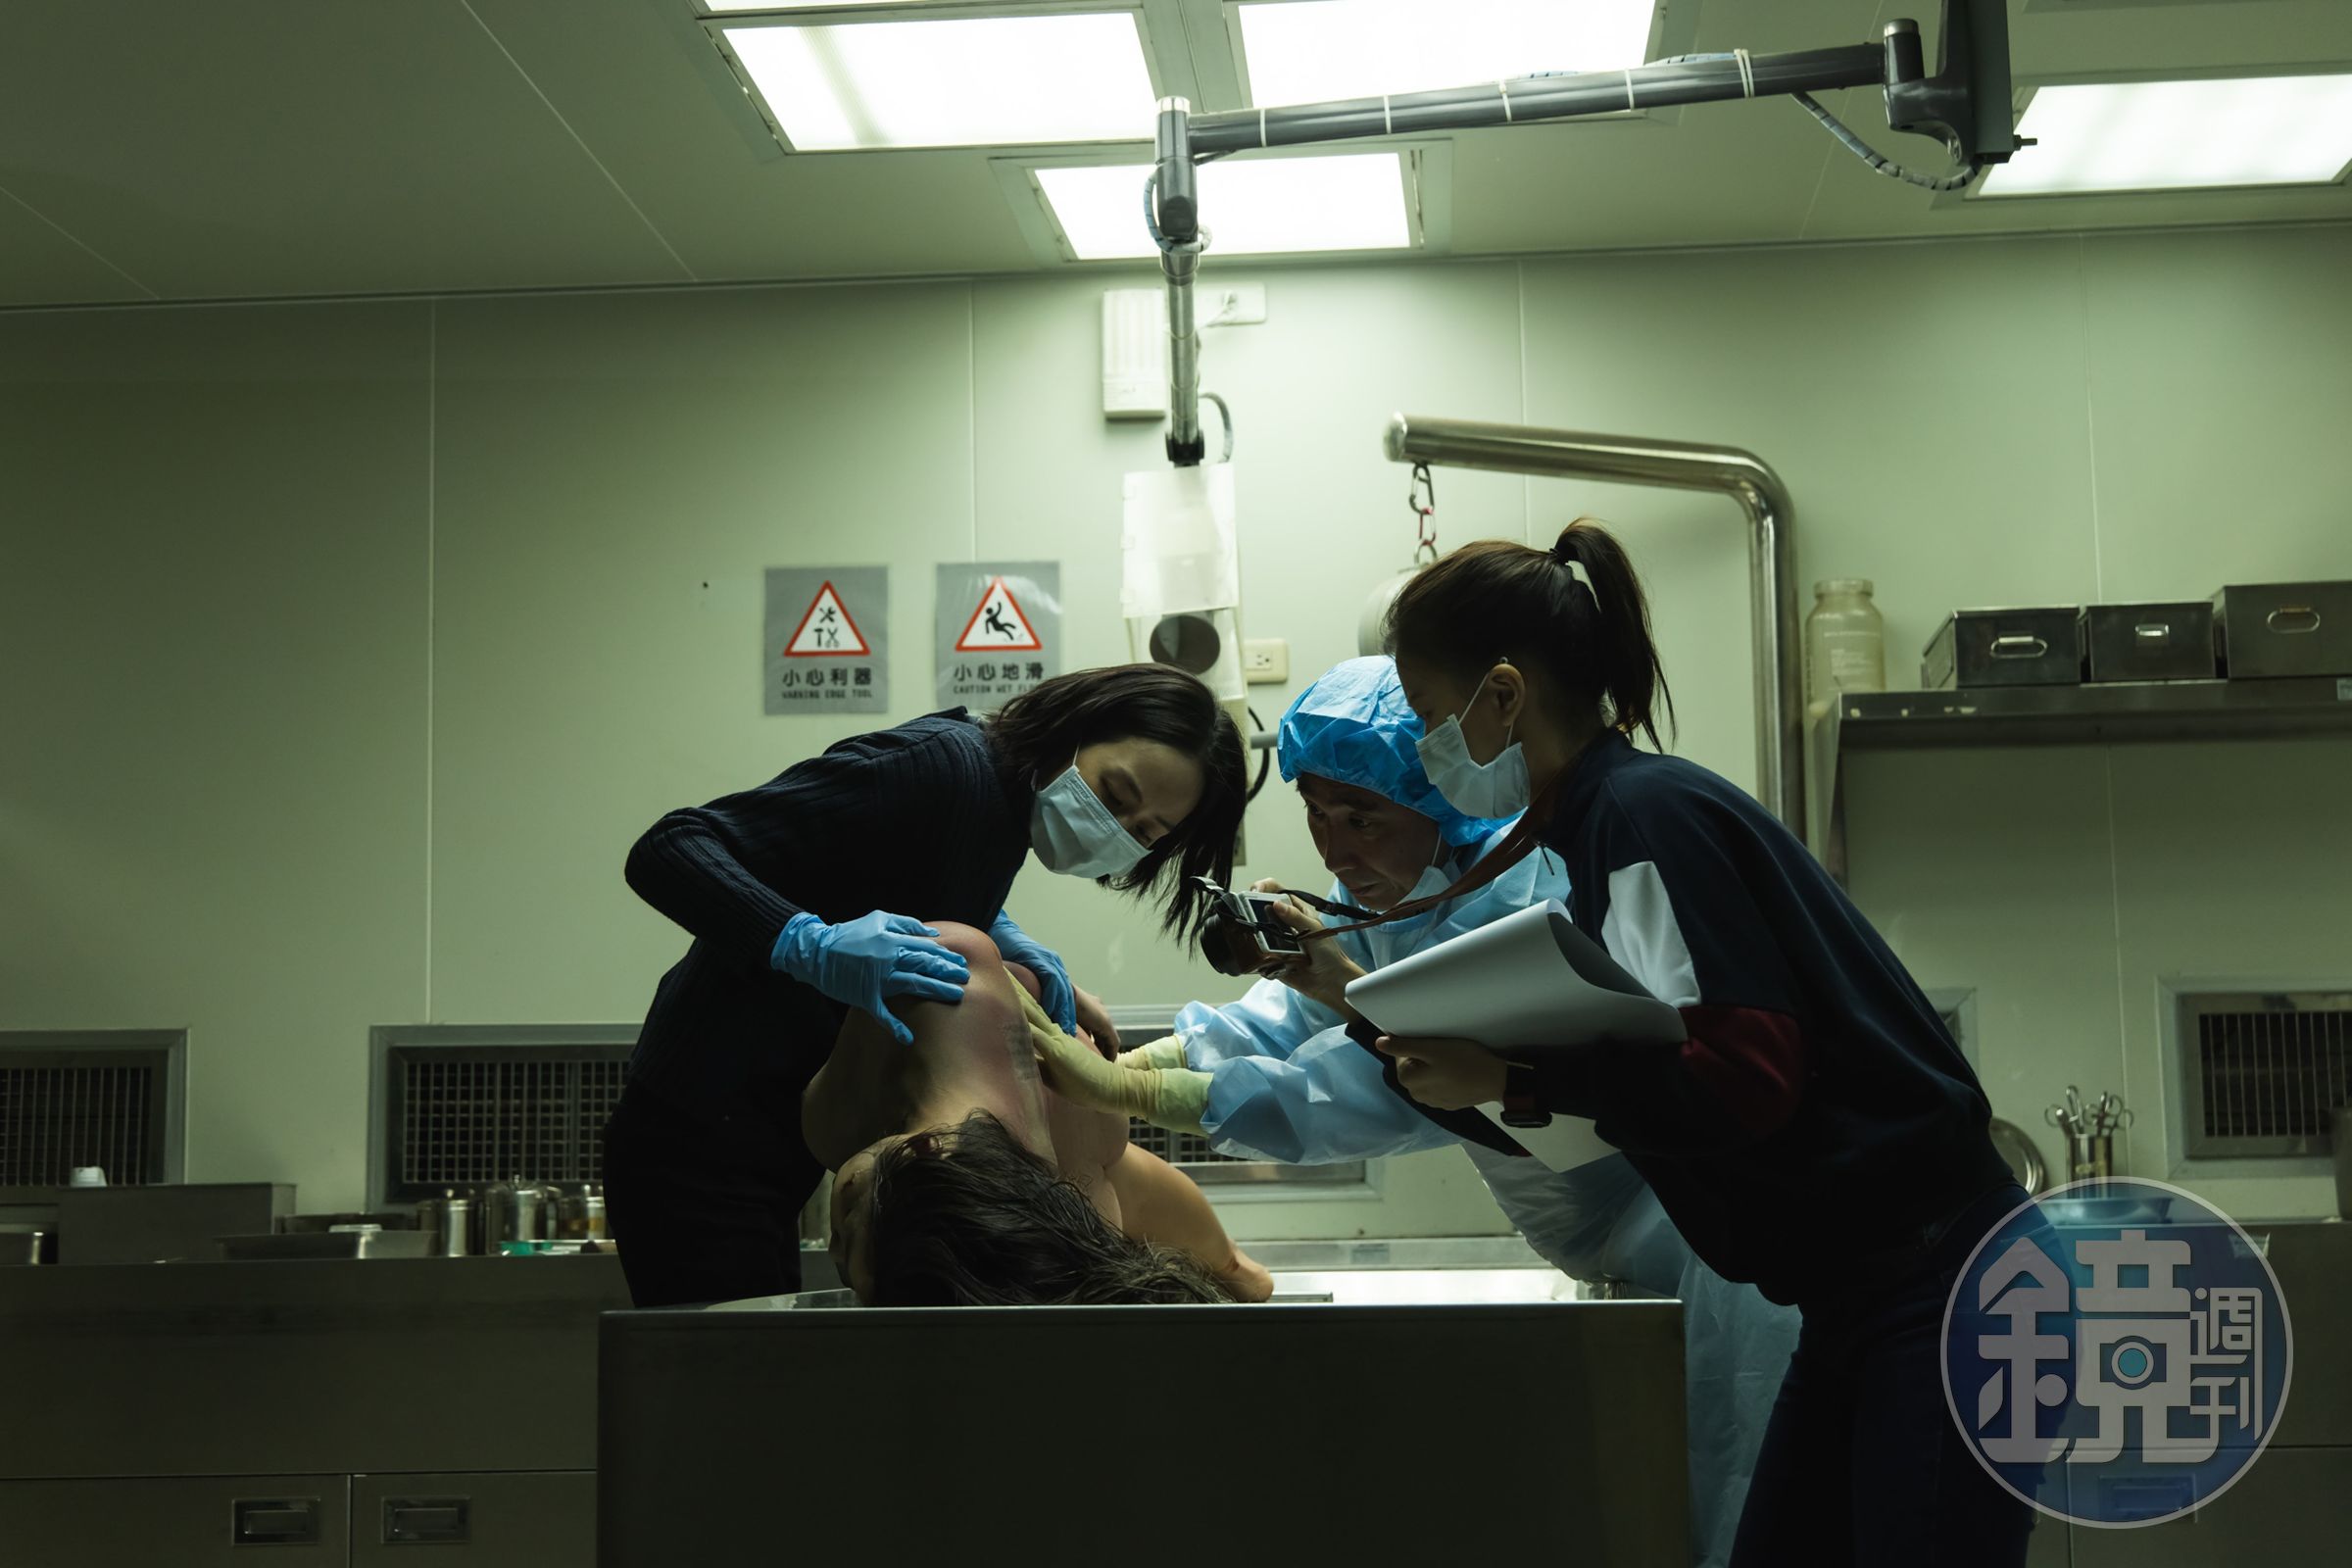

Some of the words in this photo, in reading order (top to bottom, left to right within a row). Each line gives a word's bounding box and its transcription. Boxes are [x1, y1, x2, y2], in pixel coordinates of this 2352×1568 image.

[782, 666, 871, 687] 小心利器
[954, 662, 1044, 682] 小心地滑
[954, 684, 991, 695] CAUTION
